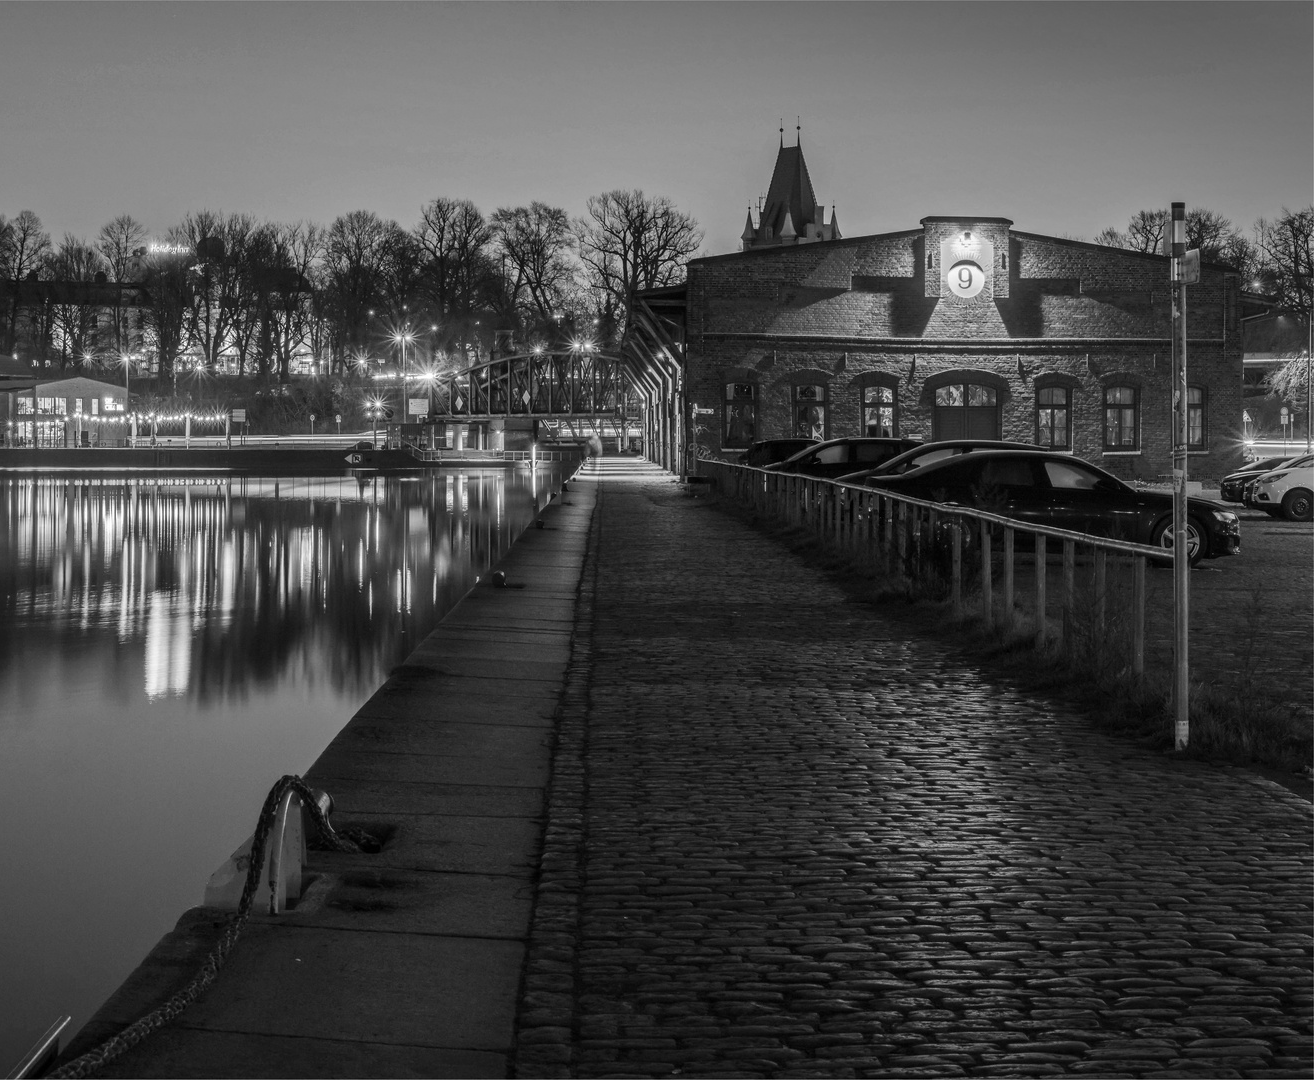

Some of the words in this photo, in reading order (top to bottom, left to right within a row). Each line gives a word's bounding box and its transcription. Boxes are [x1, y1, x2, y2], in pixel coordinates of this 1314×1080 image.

[150, 243, 177, 254] Holiday
[177, 244, 189, 253] Inn
[958, 267, 973, 289] 9
